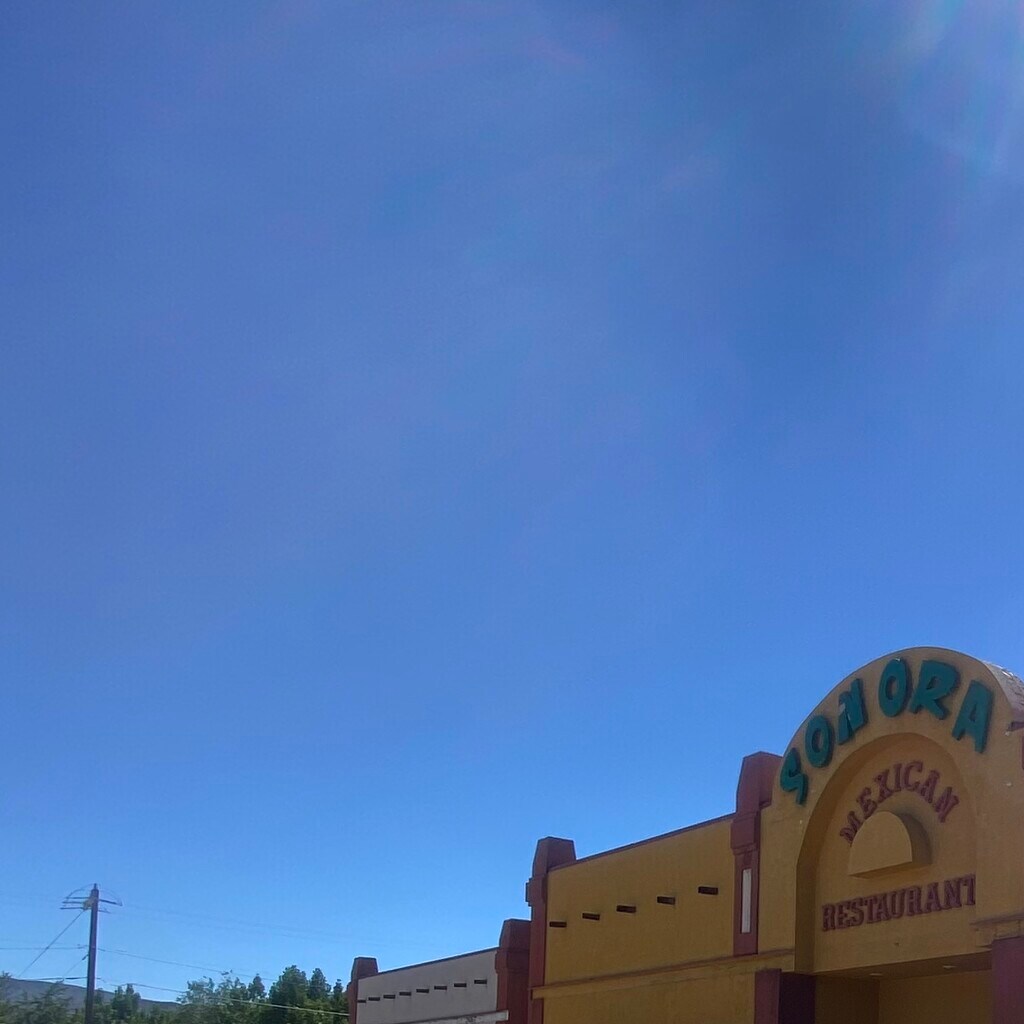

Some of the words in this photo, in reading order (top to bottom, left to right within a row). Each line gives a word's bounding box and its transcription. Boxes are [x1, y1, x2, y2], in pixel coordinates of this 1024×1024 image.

[780, 657, 994, 805] SONORA
[840, 760, 959, 847] MEXICAN
[821, 873, 976, 932] RESTAURANT
